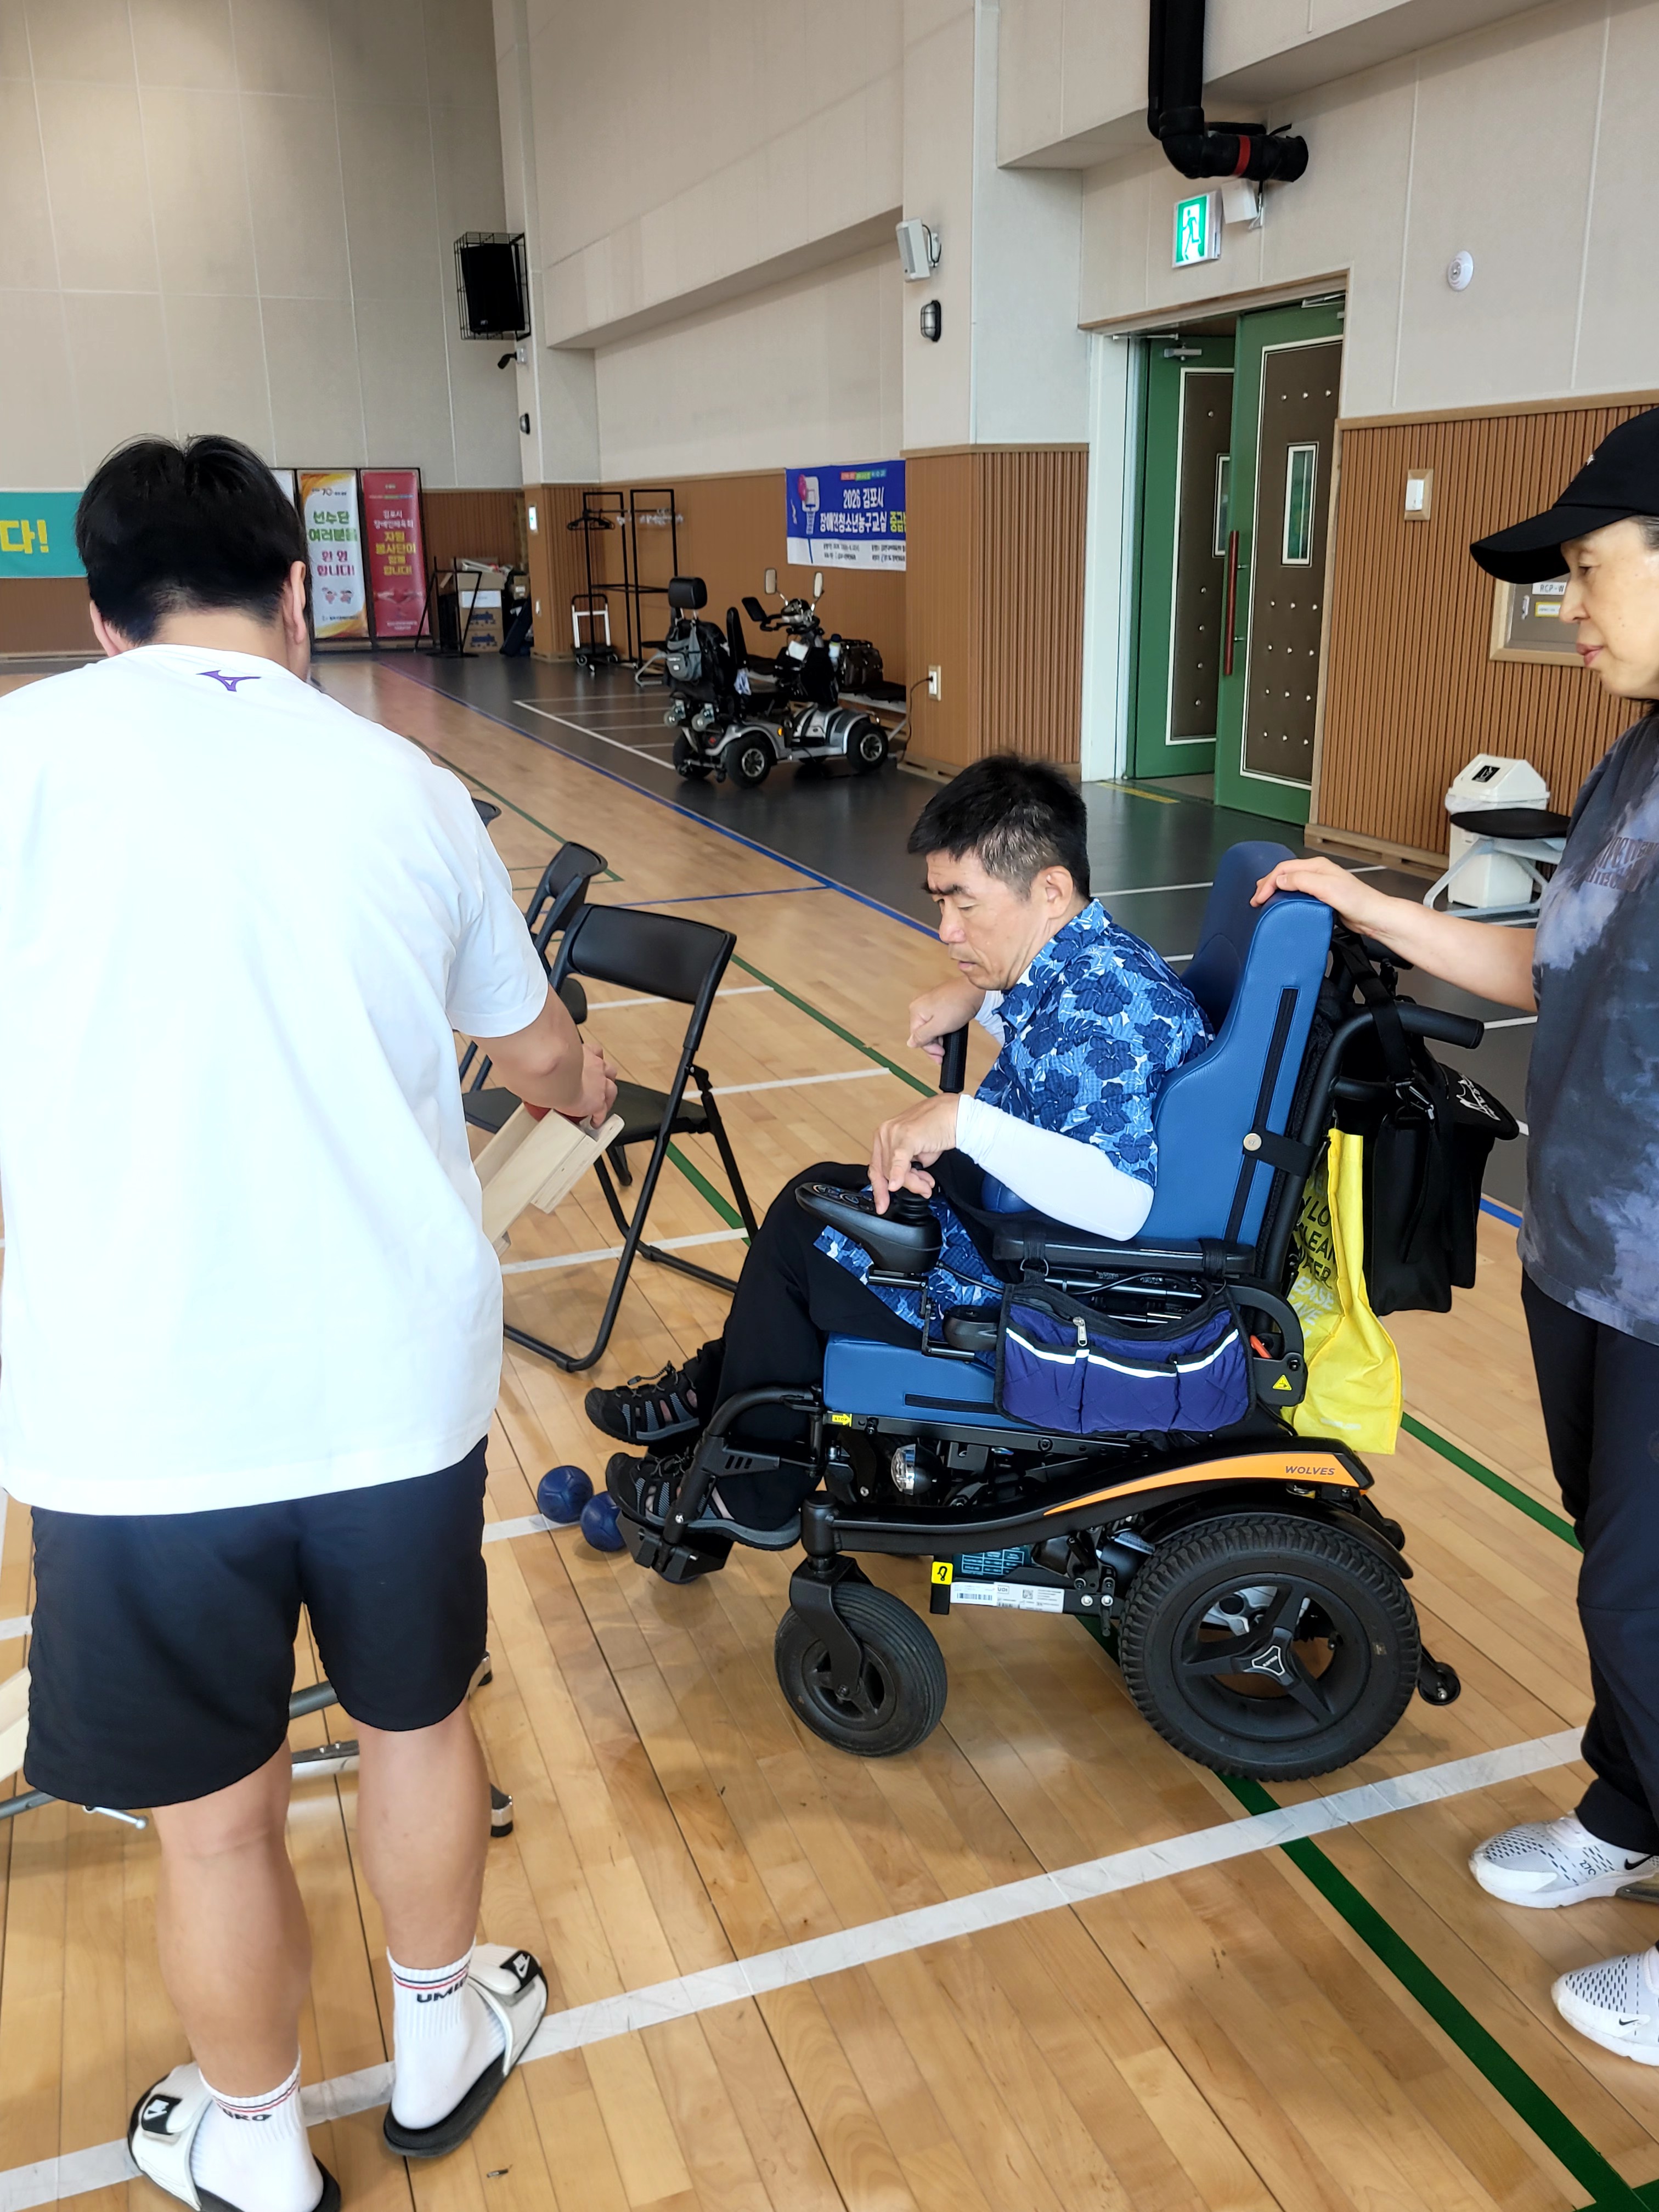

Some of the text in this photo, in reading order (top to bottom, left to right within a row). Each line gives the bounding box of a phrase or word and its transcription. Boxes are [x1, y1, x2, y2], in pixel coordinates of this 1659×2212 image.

[862, 486, 884, 509] 김포시
[313, 510, 349, 524] 선수단
[890, 511, 906, 533] 중급
[1285, 1466, 1336, 1475] WOLVES
